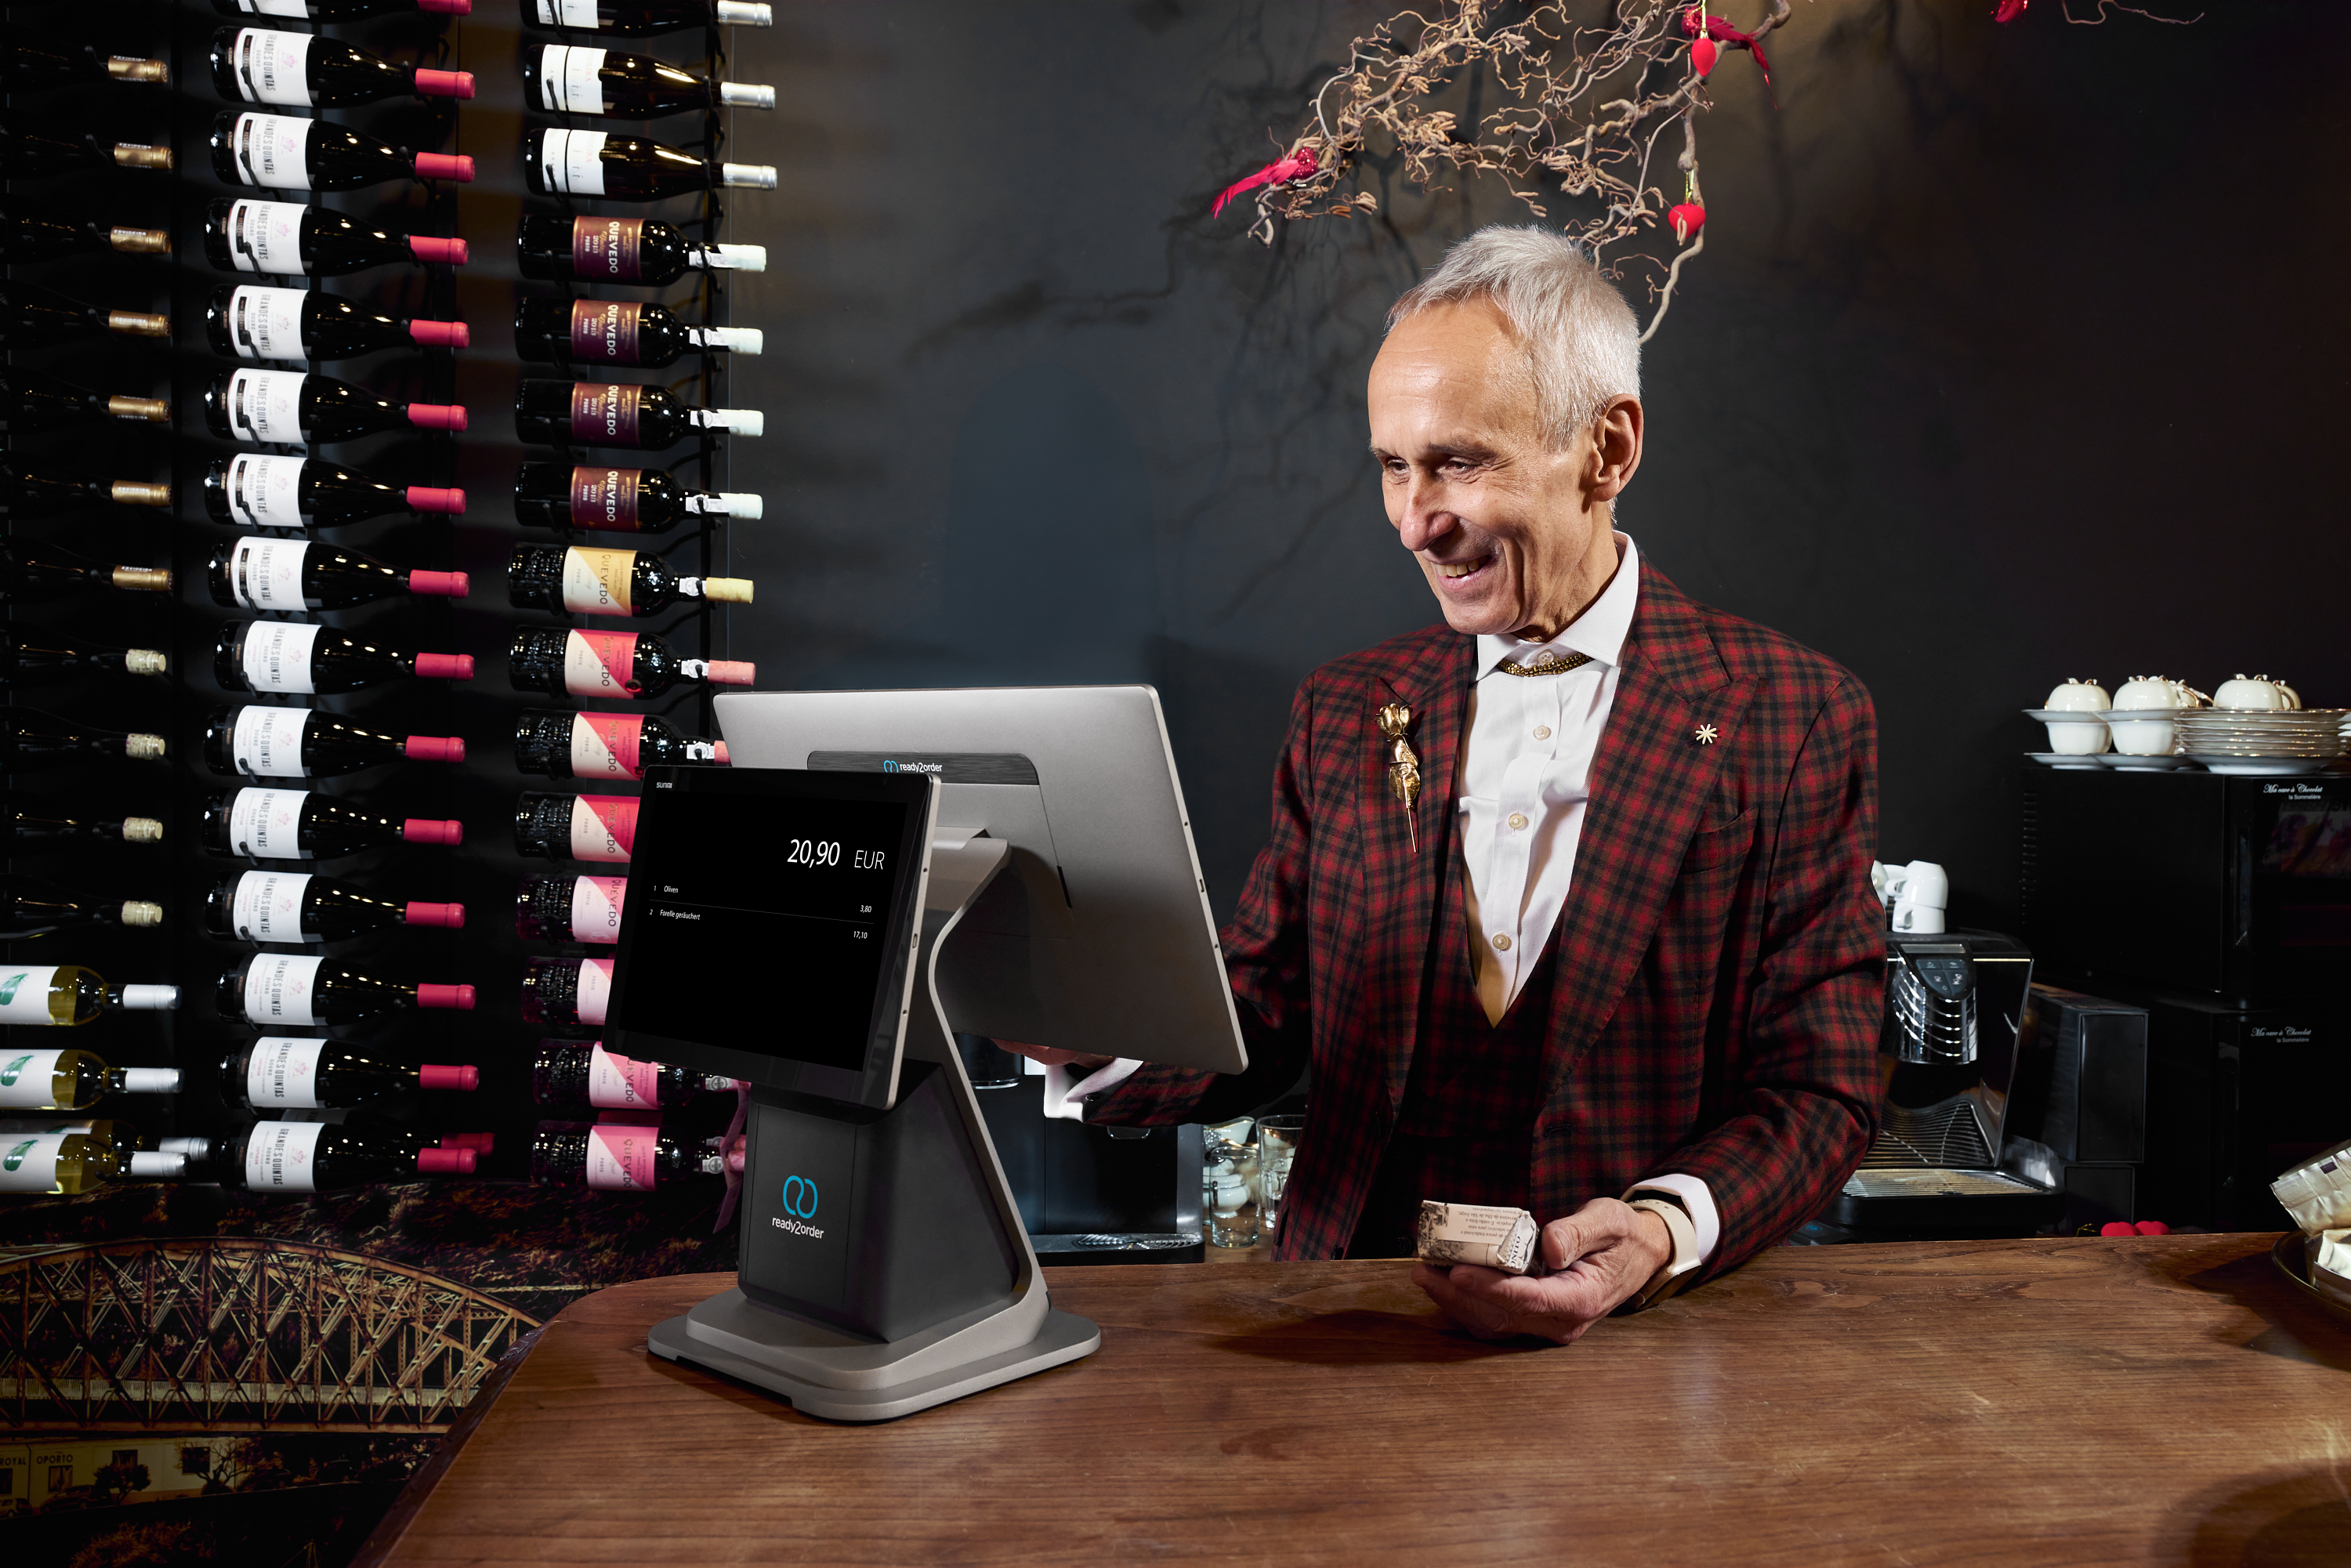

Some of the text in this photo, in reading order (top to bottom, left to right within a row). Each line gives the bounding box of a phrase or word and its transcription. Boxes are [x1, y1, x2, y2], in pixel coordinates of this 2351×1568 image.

[263, 62, 276, 91] QUINTAS
[263, 145, 275, 175] QUINTAS
[256, 230, 269, 260] QUINTAS
[609, 221, 620, 273] QUEVEDO
[258, 323, 271, 351] QUINTAS
[607, 304, 618, 356] QUEVEDO
[257, 407, 269, 434] QUINTAS
[607, 385, 619, 436] QUEVEDO
[255, 485, 267, 513] QUINTAS
[606, 471, 618, 522] QUEVEDO
[259, 575, 272, 601] QUINTAS
[600, 554, 610, 605] QUEVEDO
[270, 657, 281, 684] QUINTAS
[601, 636, 614, 686] QUEVEDO
[260, 741, 272, 768] QUINTAS
[608, 720, 619, 772] QUEVEDO
[899, 762, 943, 773] ready2order
[2263, 783, 2278, 793] Ma
[2296, 783, 2323, 793] Chocolat
[257, 819, 268, 848] QUINTAS
[607, 802, 618, 853] QUEVEDO
[787, 838, 885, 870] 20,90 EUR
[608, 879, 621, 927] QUEVEDO
[664, 885, 679, 893] Oliven
[860, 904, 872, 914] 3,80
[259, 905, 270, 933] QUINTAS
[660, 909, 675, 918] Forelle
[675, 911, 701, 921] geräuchert
[853, 930, 868, 940] 17,10
[271, 988, 282, 1016] QUINTAS
[2251, 1027, 2266, 1037] Ma
[2284, 1026, 2312, 1036] Chocolat
[274, 1069, 284, 1098] QUINTAS
[625, 1059, 635, 1103] UEVEDO
[272, 1157, 284, 1185] QUINTAS
[623, 1139, 633, 1188] QUEVEDO
[772, 1217, 824, 1239] ready2order
[1510, 1236, 1520, 1268] ONITO
[0, 1454, 73, 1465] ROYAL OPORTO
